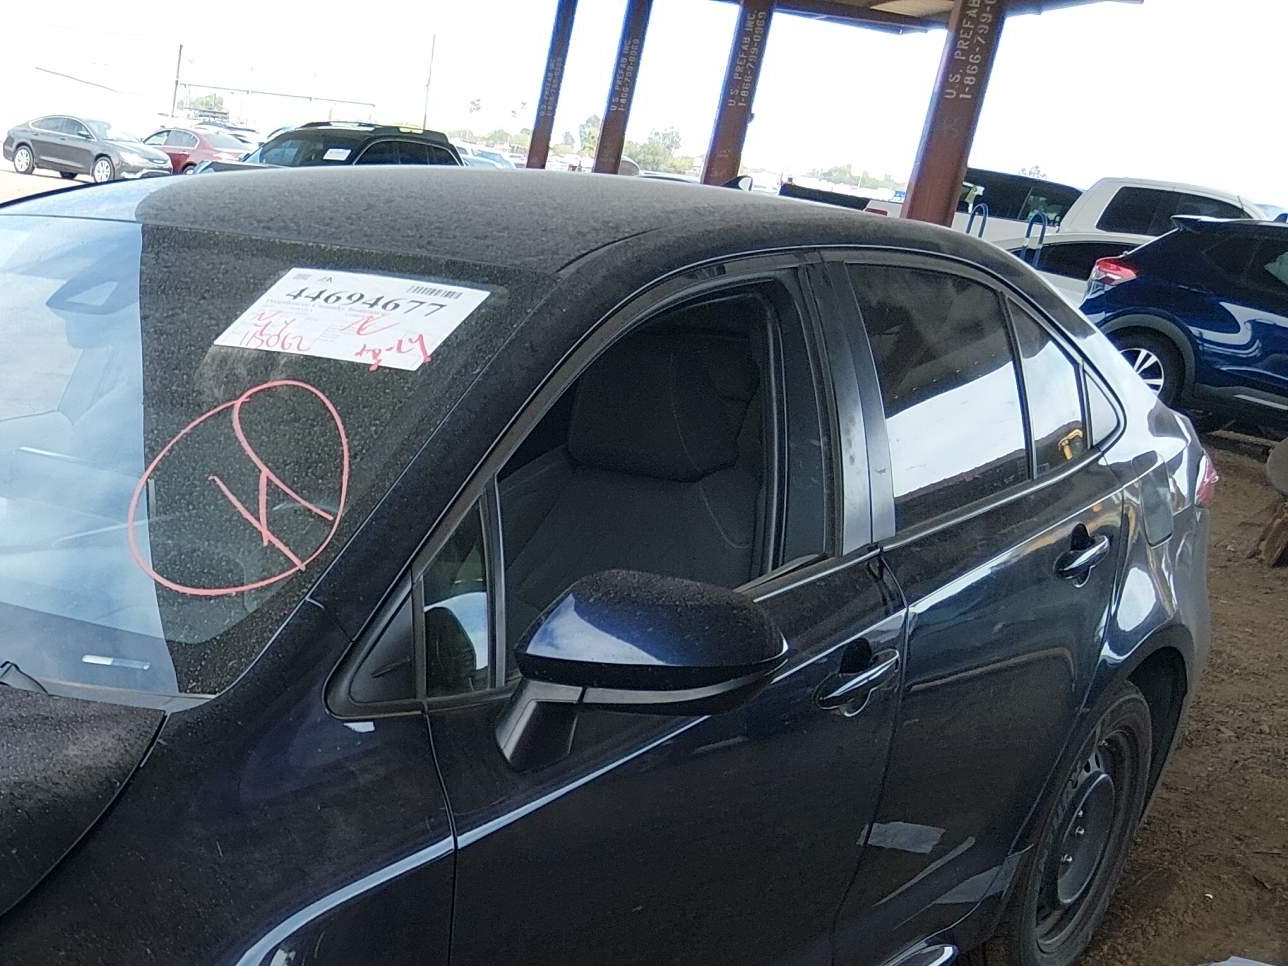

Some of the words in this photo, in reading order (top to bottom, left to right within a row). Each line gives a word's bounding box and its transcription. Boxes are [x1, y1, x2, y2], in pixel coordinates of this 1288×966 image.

[733, 36, 752, 80] PREFAB
[943, 68, 965, 99] U.S.
[285, 286, 448, 318] 44694677
